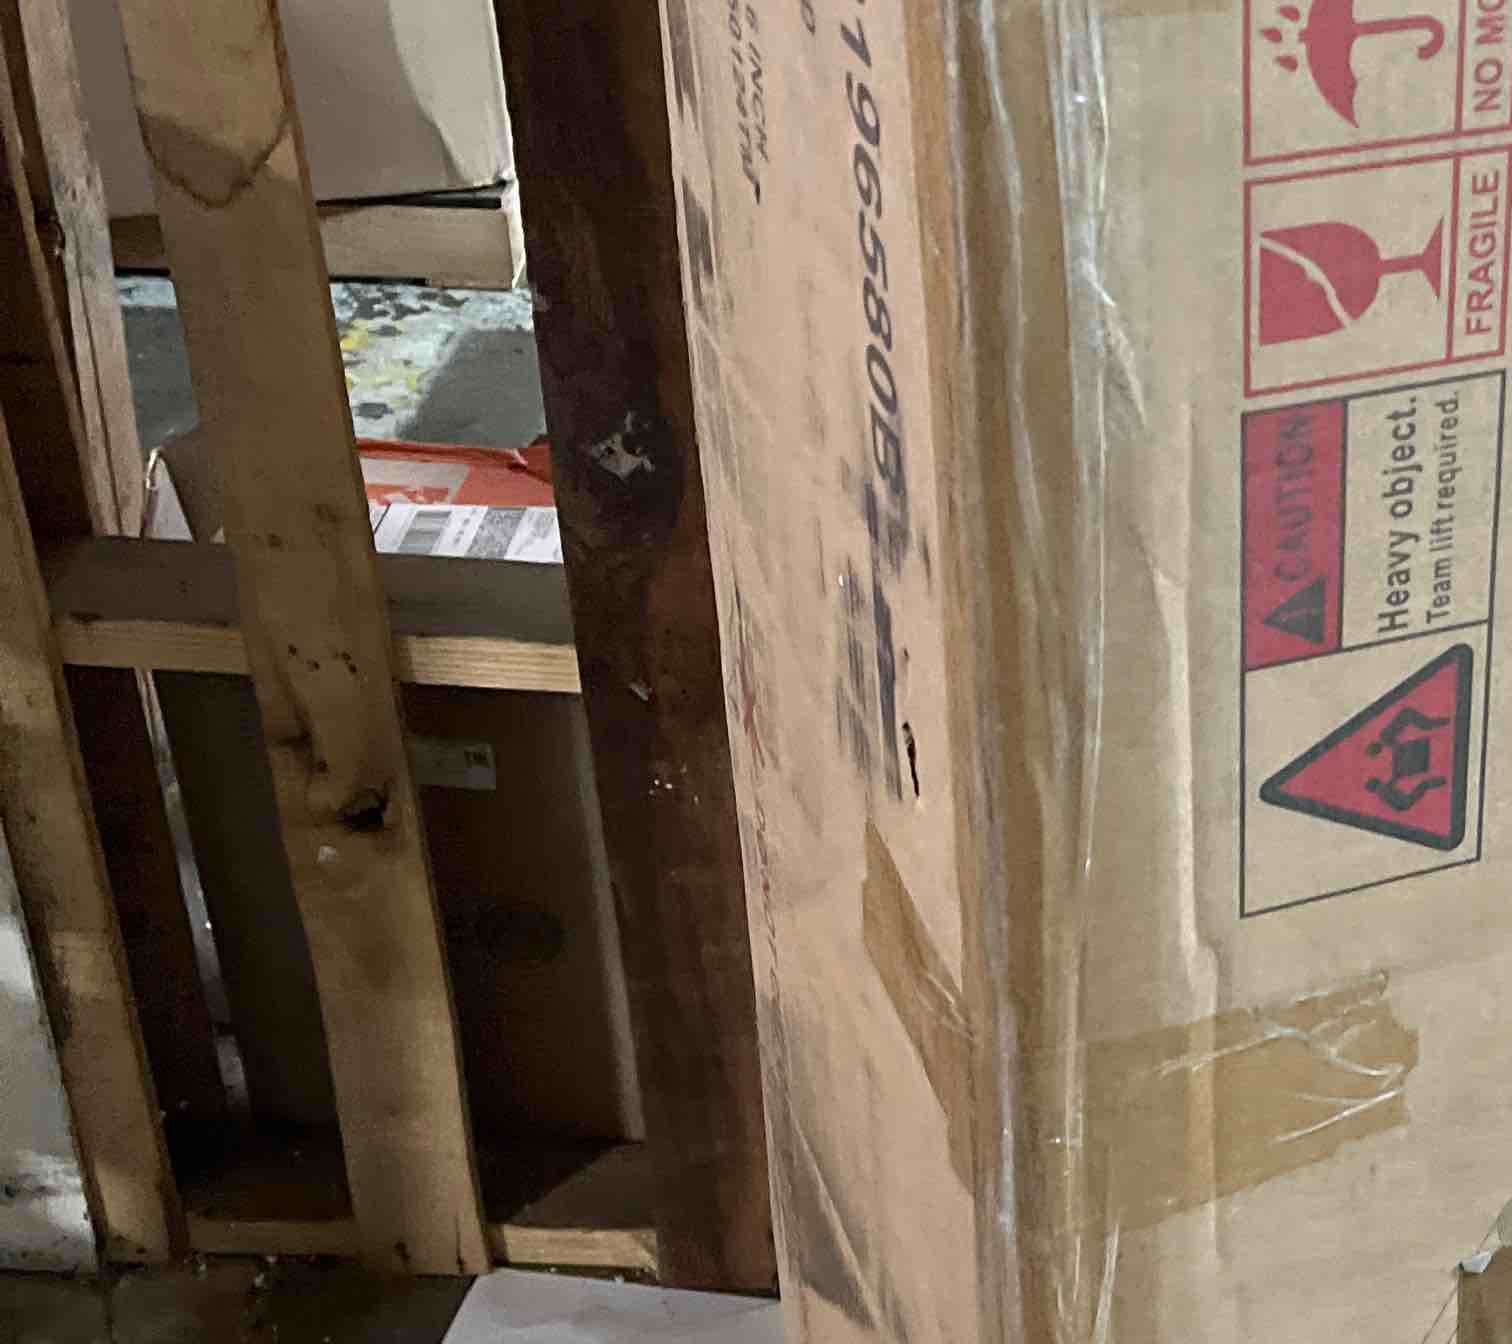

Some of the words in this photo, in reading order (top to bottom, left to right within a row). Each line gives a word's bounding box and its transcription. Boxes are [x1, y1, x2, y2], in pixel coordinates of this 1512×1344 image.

[747, 39, 770, 163] INCH
[1474, 58, 1503, 113] NO
[1466, 169, 1501, 337] FRAGILE
[1273, 413, 1315, 585] CAUTION
[1391, 394, 1424, 523] object.
[1434, 388, 1462, 513] required.
[1377, 522, 1421, 635] Heavy
[1425, 561, 1454, 625] Team
[1428, 514, 1455, 559] lift
